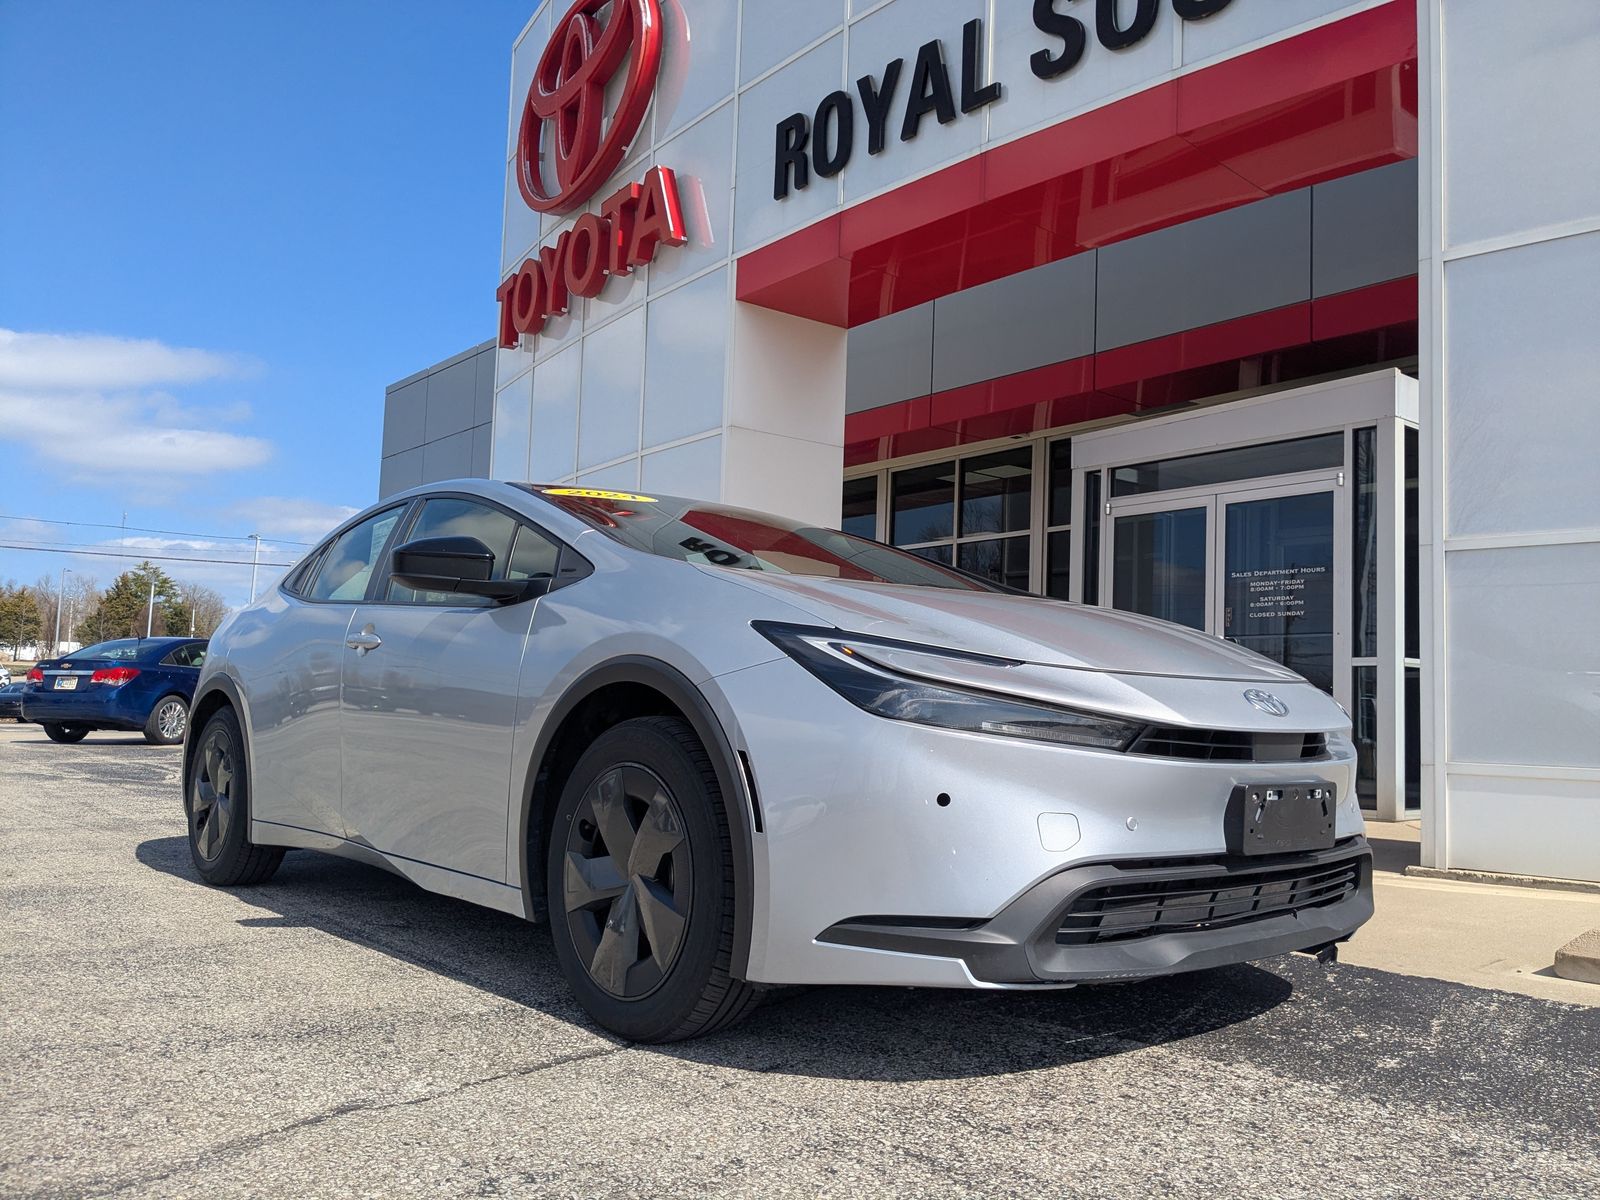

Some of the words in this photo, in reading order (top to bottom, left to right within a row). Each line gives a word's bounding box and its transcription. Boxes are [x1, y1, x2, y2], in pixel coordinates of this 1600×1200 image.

[773, 18, 1001, 200] ROYAL
[496, 165, 687, 349] TOYOTA
[1250, 579, 1305, 587] MONDAY-FRIDAY
